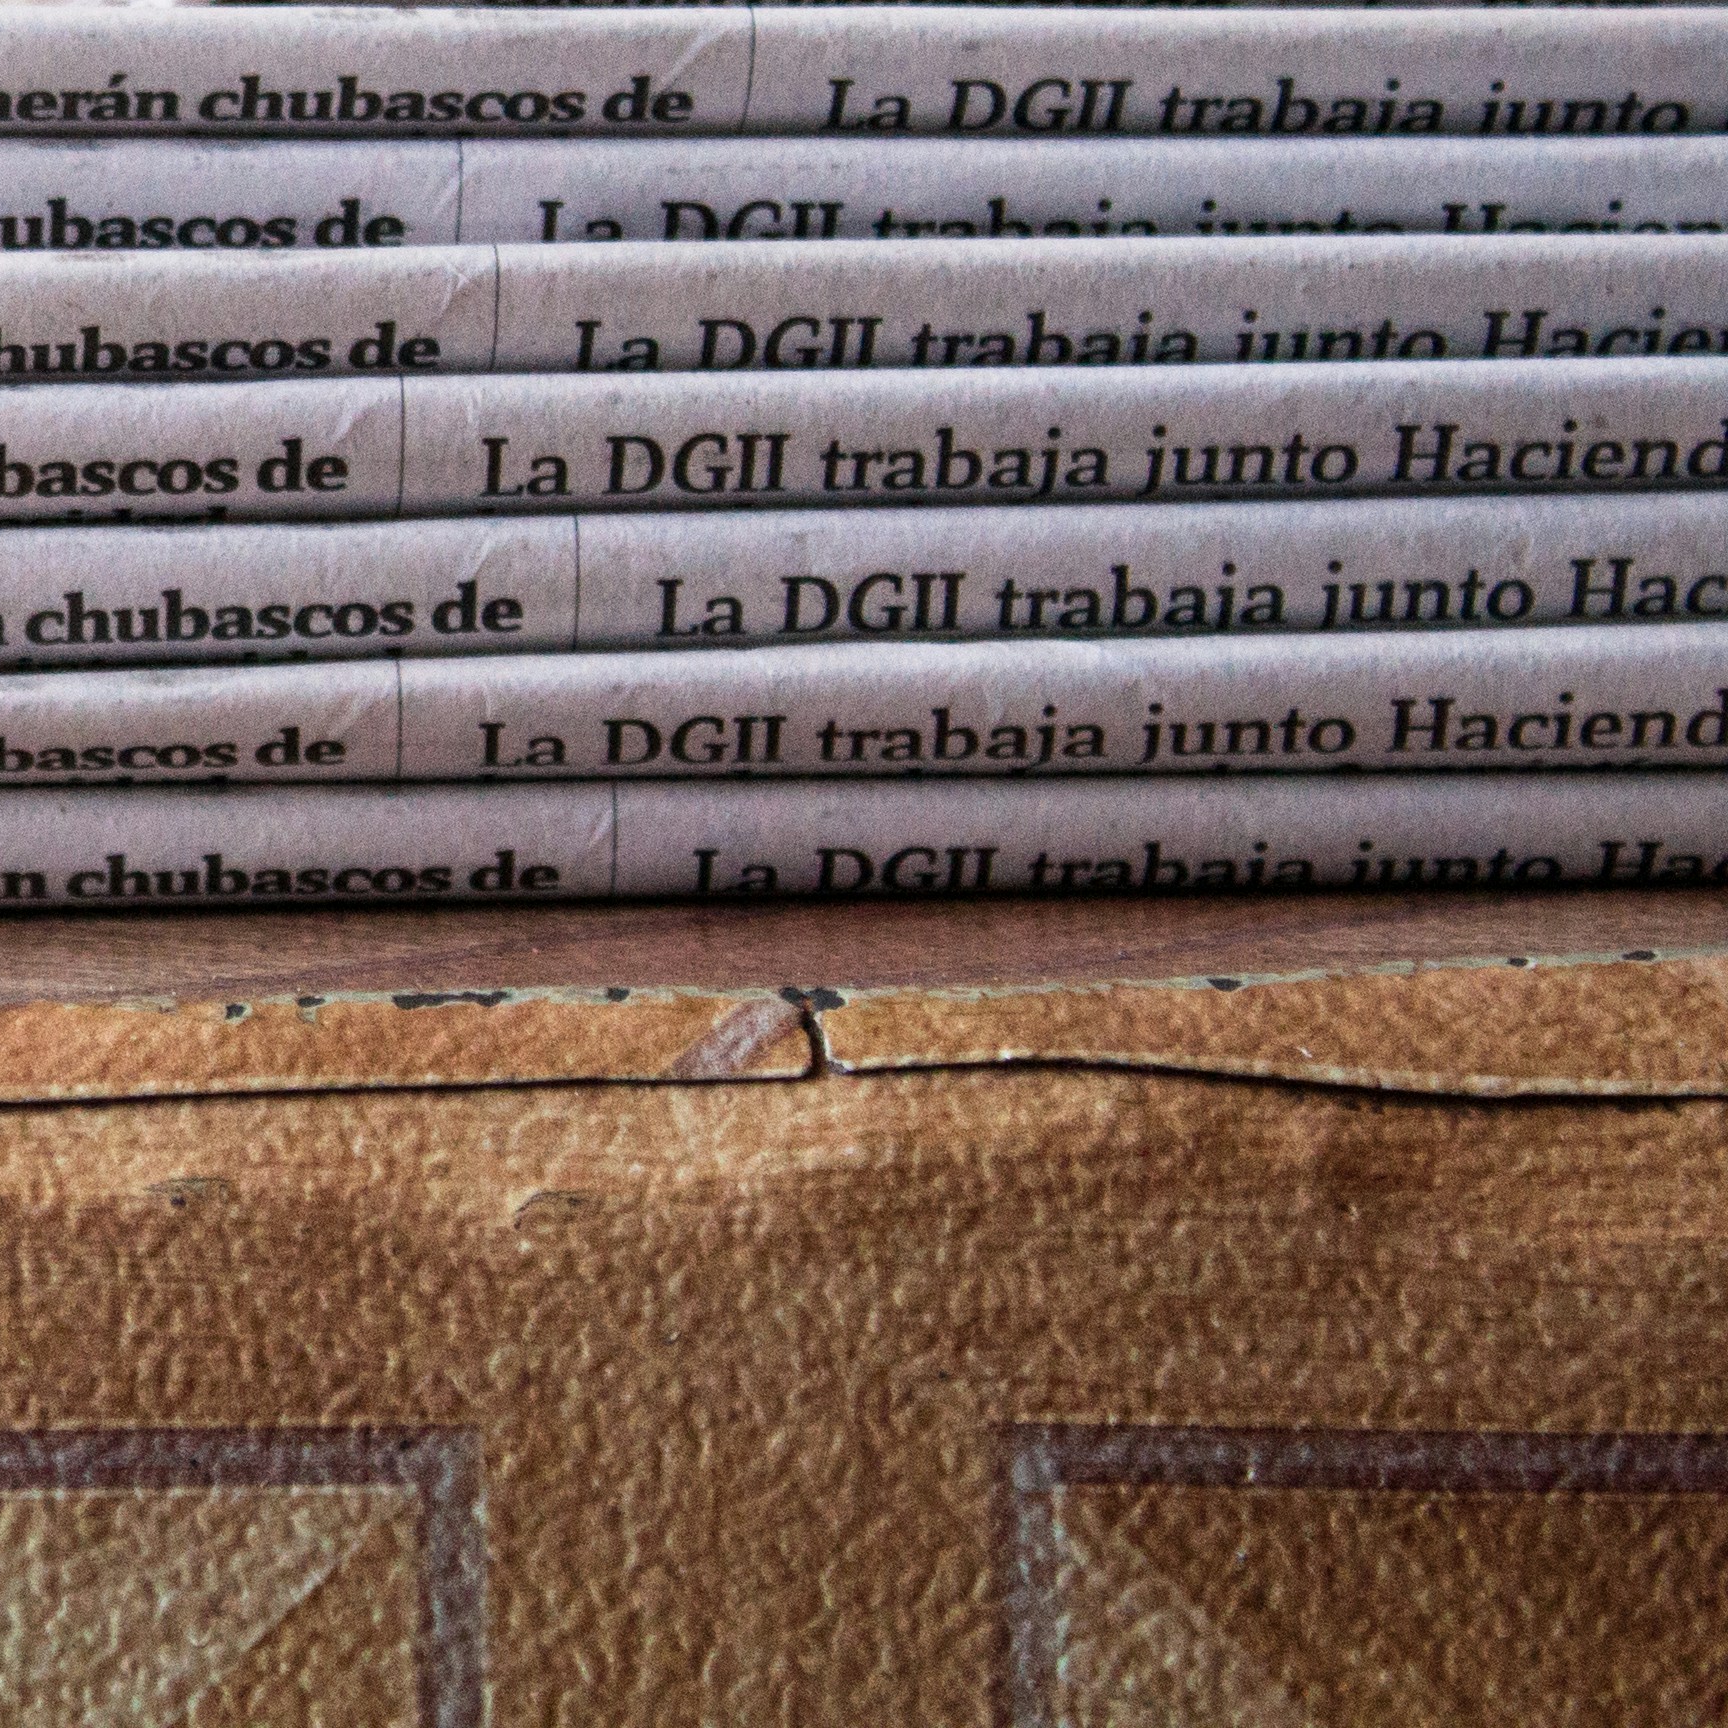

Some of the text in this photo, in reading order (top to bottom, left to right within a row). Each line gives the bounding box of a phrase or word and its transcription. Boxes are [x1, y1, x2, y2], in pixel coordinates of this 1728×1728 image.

[198, 75, 586, 124] chubascos
[600, 75, 695, 124] de
[821, 78, 914, 131] La
[946, 77, 1134, 133] DGII
[312, 198, 406, 249] de
[346, 321, 441, 372] de
[574, 320, 661, 370] La
[697, 315, 884, 368] DGII
[1481, 306, 1728, 358] Hacie
[255, 436, 349, 495] de
[480, 436, 570, 498] La
[601, 431, 791, 495] DGII
[820, 426, 1110, 497] trabaja
[1142, 424, 1360, 497] junto
[23, 589, 415, 645] chubascos
[430, 581, 523, 635] de
[656, 556, 1728, 638] La DGII trabaja junto Hac
[255, 727, 346, 767] de
[478, 721, 567, 767] La
[601, 715, 788, 765] DGII
[814, 704, 1106, 771] trabaja
[1141, 702, 1356, 764] junto
[64, 853, 453, 899] chubascos
[469, 849, 560, 895] de
[1598, 838, 1728, 888] Ha
